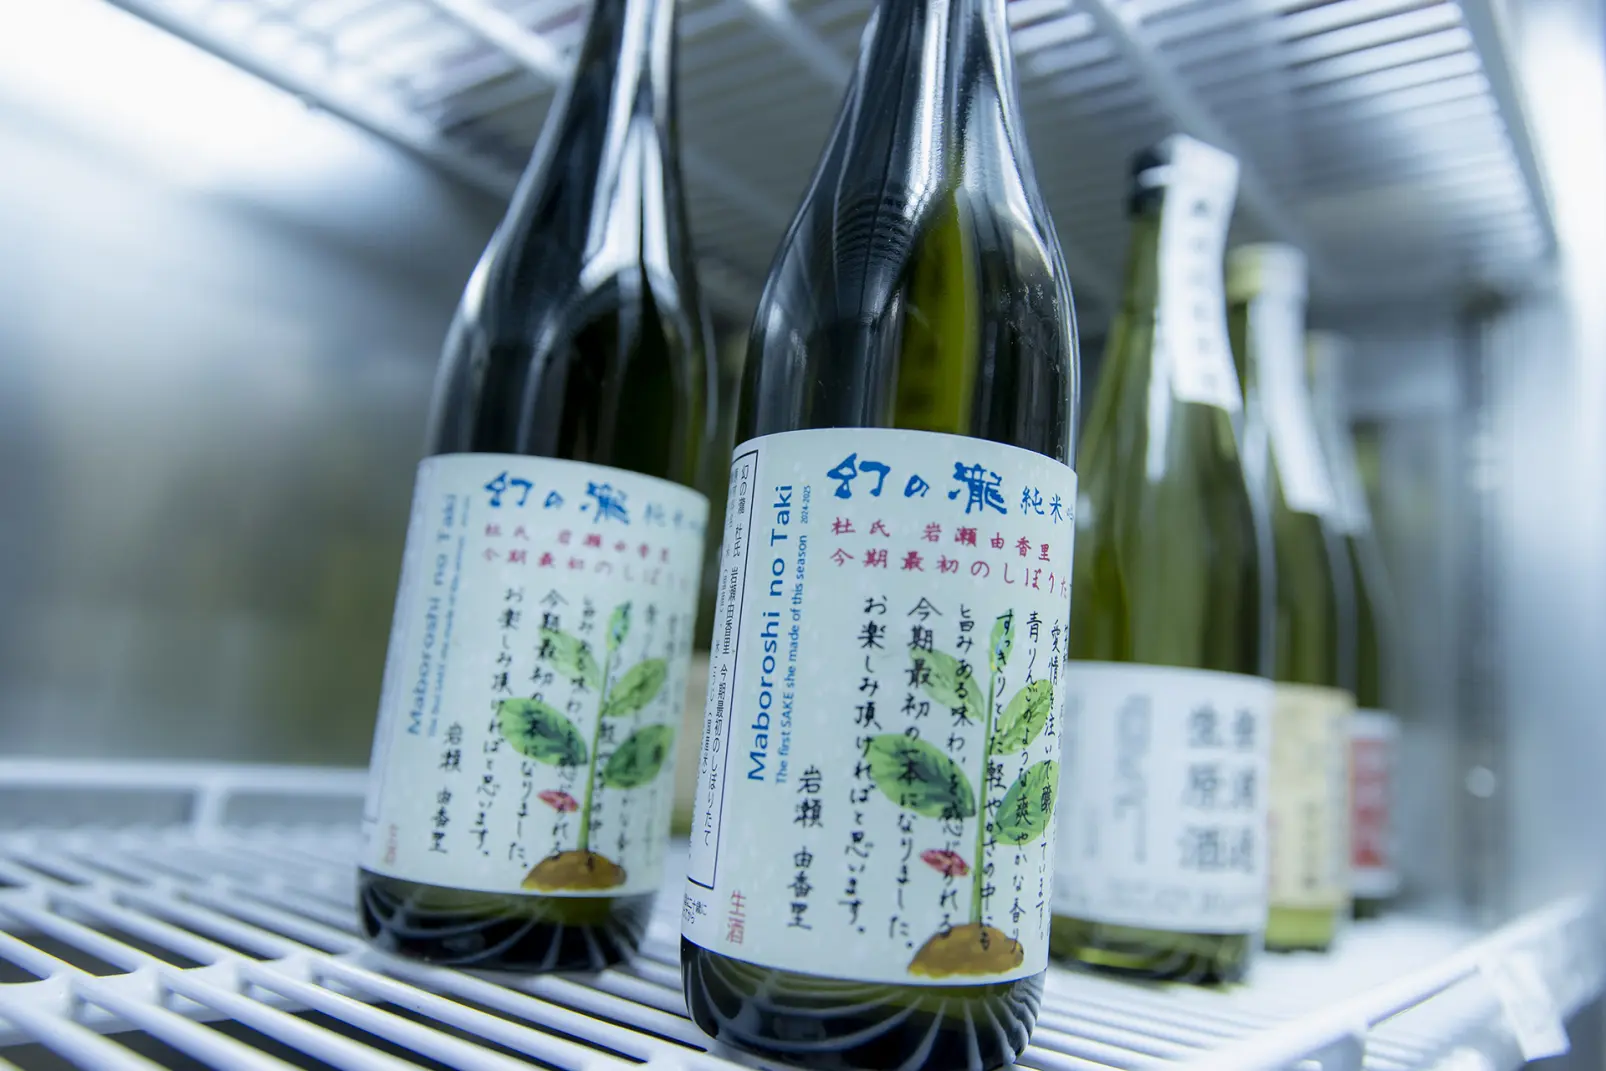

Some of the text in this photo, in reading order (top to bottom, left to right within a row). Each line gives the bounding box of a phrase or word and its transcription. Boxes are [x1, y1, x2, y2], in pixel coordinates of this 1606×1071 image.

[827, 452, 1007, 515] 幻の瀧
[831, 517, 1050, 561] 杜氏 岩瀬由香里
[407, 597, 441, 735] Maboroshi
[434, 552, 448, 586] no
[748, 485, 793, 780] Maboroshi no Taki
[775, 485, 812, 784] The first SAKE she made of this season 2024-2025
[830, 548, 1072, 599] 今期最初のしぼりた
[787, 764, 823, 930] 岩瀬 由香里
